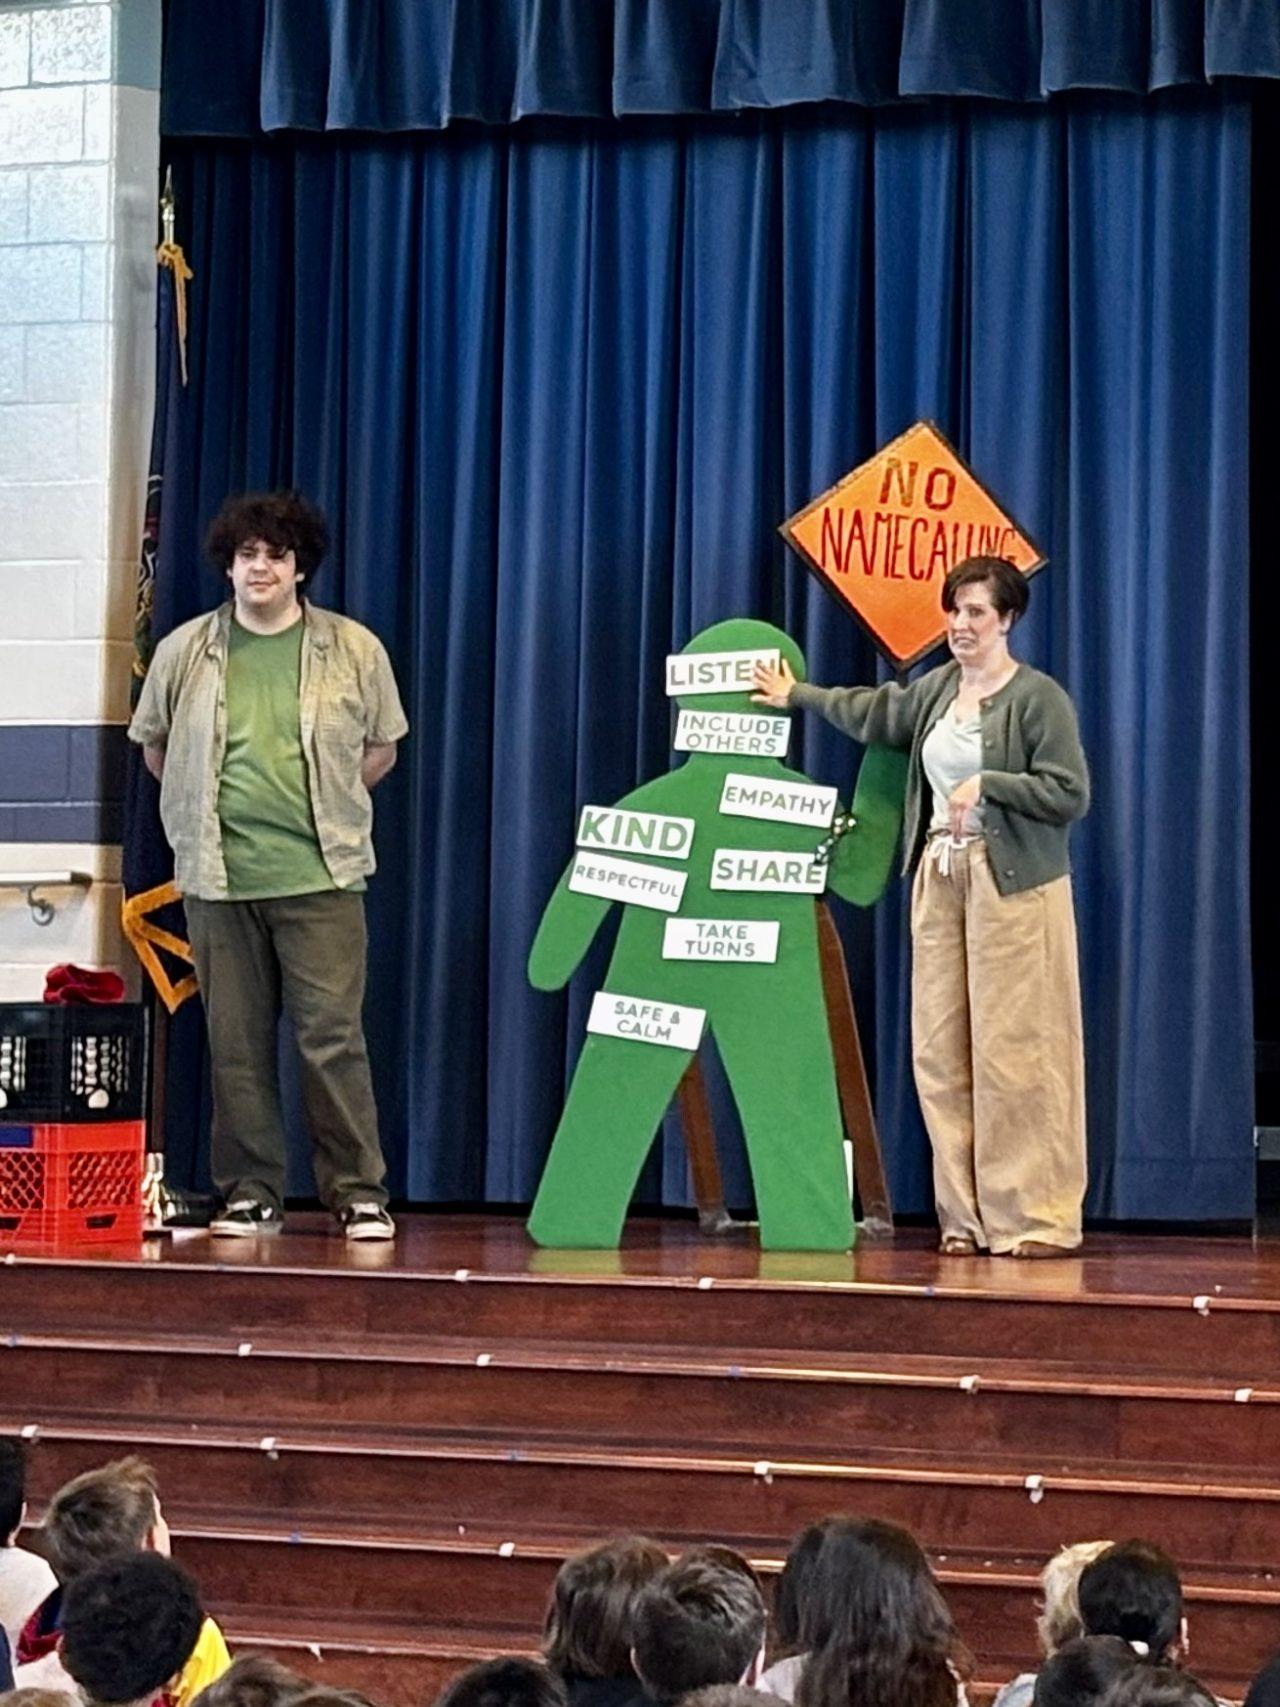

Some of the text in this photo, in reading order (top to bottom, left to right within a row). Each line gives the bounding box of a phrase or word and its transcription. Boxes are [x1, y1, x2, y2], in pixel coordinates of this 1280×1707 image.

[879, 457, 957, 512] NO
[683, 715, 785, 736] INCLUDE
[686, 733, 776, 754] OTHERS
[725, 786, 832, 816] EMPATHY
[580, 811, 688, 853] KIND
[575, 865, 679, 898] RESPECTFUL
[716, 858, 822, 884] SHARE
[696, 923, 748, 940] TAKE
[685, 940, 756, 957] TURNS
[614, 1001, 681, 1025] SAFE &
[617, 1019, 672, 1041] CALM
